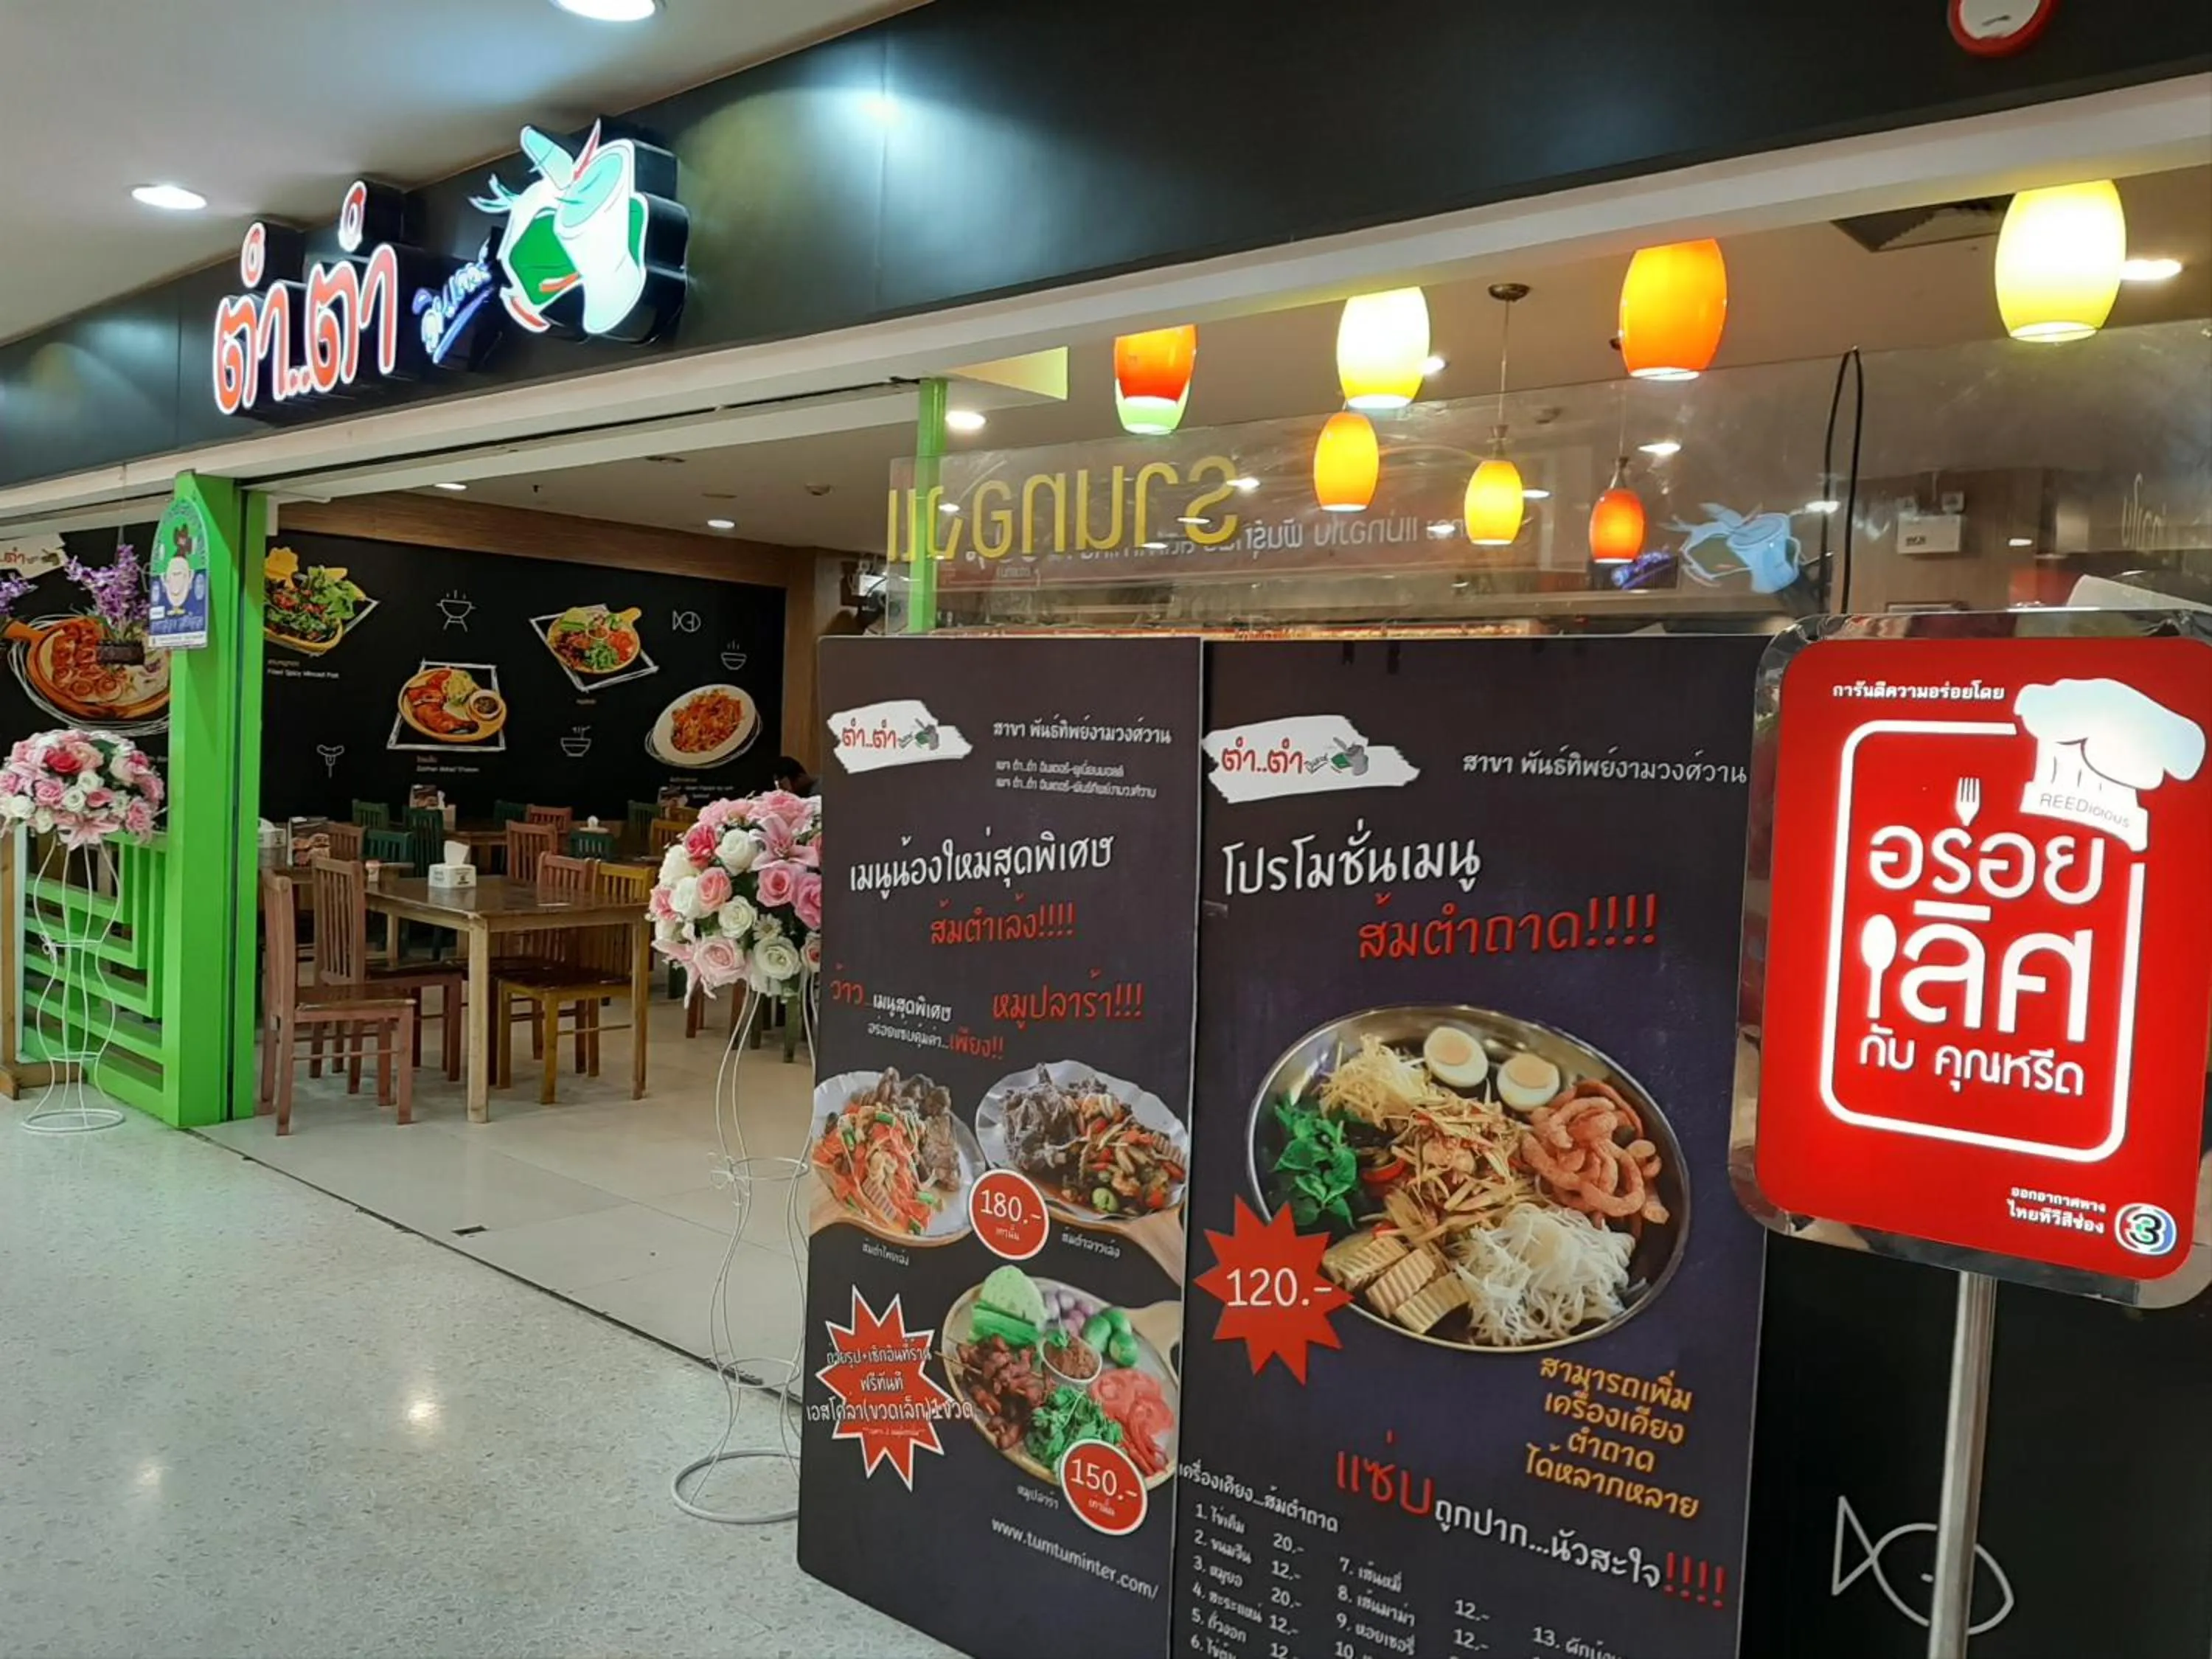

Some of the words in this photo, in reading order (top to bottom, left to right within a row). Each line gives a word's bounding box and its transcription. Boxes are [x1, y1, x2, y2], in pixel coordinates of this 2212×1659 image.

[992, 720, 1026, 737] สาขา
[1463, 754, 1512, 774] สาขา
[849, 827, 1116, 900] เมนูน้องใหม่สุดพิเศษ
[1222, 818, 1481, 895] โปรโมชั่นเมนู
[1869, 779, 2105, 905] อร่อย
[931, 893, 1077, 945] ส้มตำเล้ง!!!!
[1357, 891, 1658, 959] ส้มตำถาด!!!!
[991, 968, 1145, 1029] หมูปลาร้า!!!
[1860, 1023, 1916, 1070] กับ
[1935, 1044, 2085, 1096] คุณหรีด
[979, 1188, 1042, 1225] 180.-
[2011, 1186, 2107, 1214] ออกอากาศทาง
[1226, 1267, 1332, 1307] 120.-
[1540, 1356, 1694, 1412] สามารถเพิ่ม
[1544, 1382, 1686, 1444] เครื่องเคียง
[1070, 1458, 1138, 1501] 150.-
[1567, 1427, 1656, 1474] ตำถาด
[1524, 1441, 1700, 1519] ได้หลากหลาย
[991, 1517, 1159, 1601] www.tumtuminter.com/
